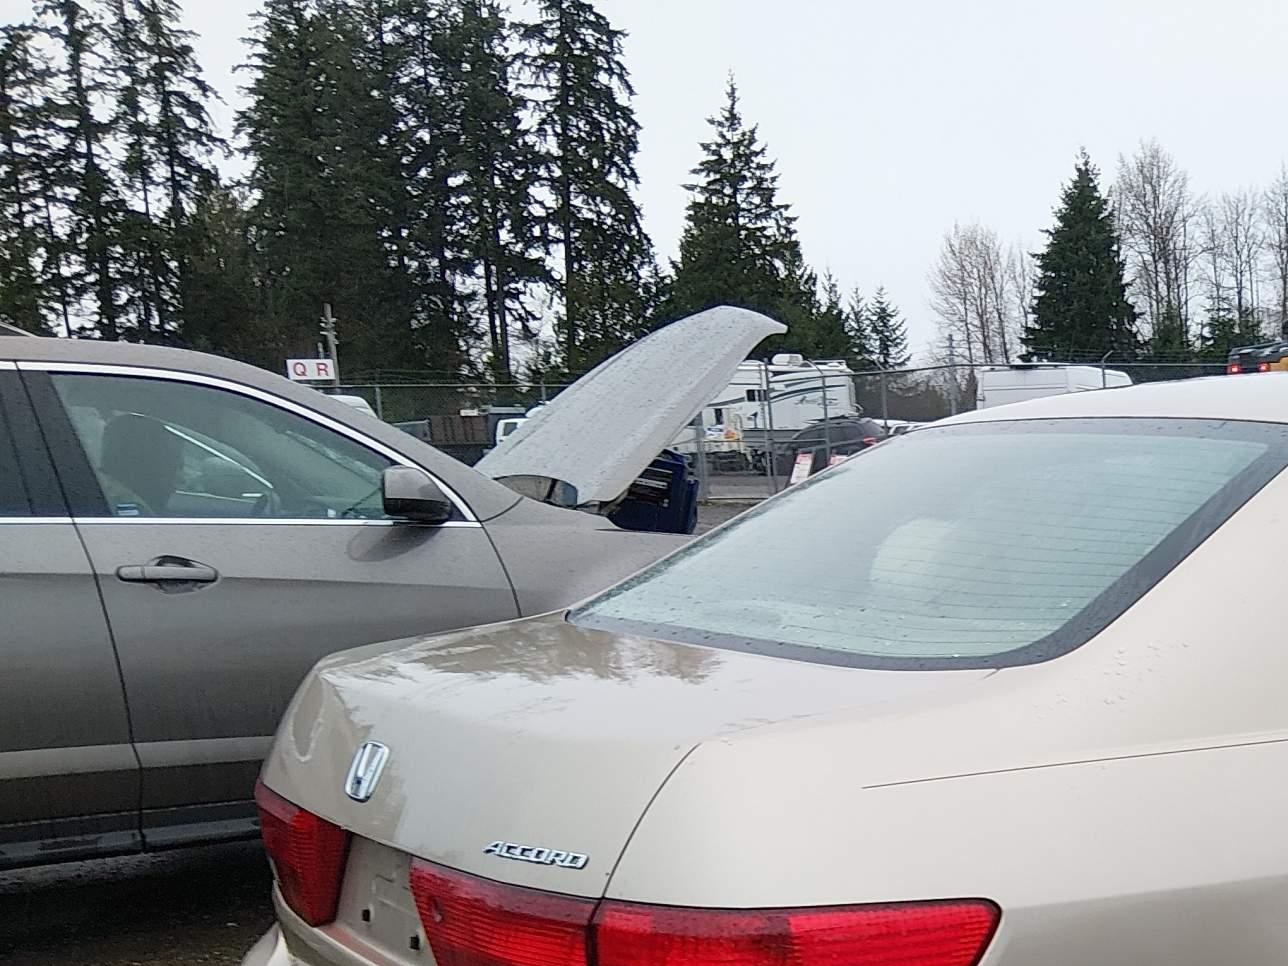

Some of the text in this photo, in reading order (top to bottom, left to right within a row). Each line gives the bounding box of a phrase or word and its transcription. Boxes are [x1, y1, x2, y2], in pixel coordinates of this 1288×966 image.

[293, 362, 329, 377] Q R
[483, 840, 590, 870] ACCORD
